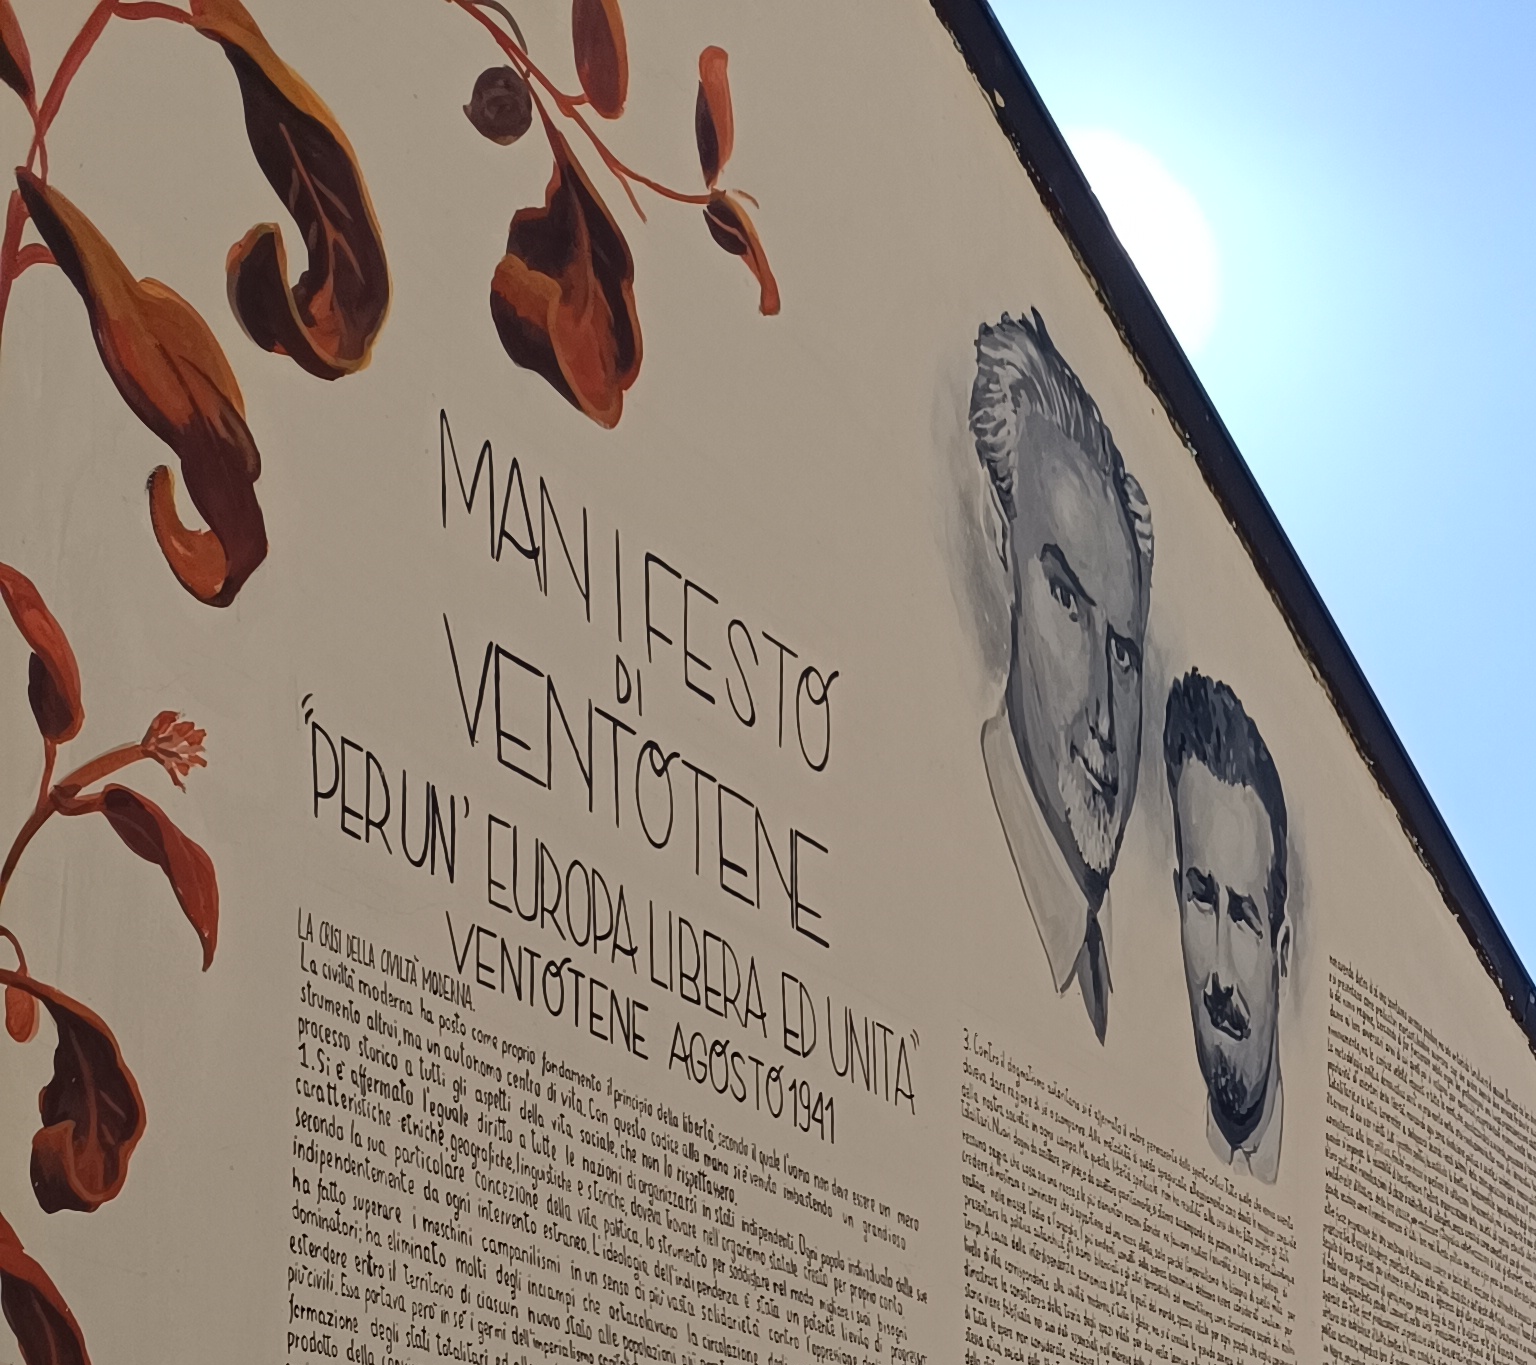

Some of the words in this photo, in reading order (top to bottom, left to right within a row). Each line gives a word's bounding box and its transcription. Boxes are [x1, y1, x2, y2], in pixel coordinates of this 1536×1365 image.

[438, 408, 840, 773] MANIFESTO
[615, 655, 643, 717] DI
[442, 612, 830, 948] VENTOTENE
[298, 907, 314, 944] LA
[319, 921, 342, 955] CRISI
[347, 933, 376, 970] DELLA
[486, 813, 638, 975] EUROPA
[648, 898, 768, 1039] LIBERA
[781, 970, 818, 1059] ED
[298, 1017, 351, 1052] processo
[358, 1035, 399, 1071] storico
[405, 1059, 414, 1078] a
[419, 1056, 446, 1094] tutti
[453, 1076, 467, 1104] gli
[475, 1087, 511, 1125] aspetti
[520, 1100, 545, 1136] della
[300, 980, 361, 1025] strumento
[403, 1028, 423, 1052] ma
[427, 1038, 441, 1058] un
[444, 1042, 503, 1083] autonomo
[507, 1069, 541, 1098] centro
[547, 1082, 557, 1104] di
[301, 941, 319, 977] La
[358, 979, 414, 1016] moderna
[420, 997, 435, 1025] ha
[471, 1027, 499, 1051] come
[502, 1040, 536, 1066] proprio
[614, 1089, 653, 1118] principio
[445, 910, 649, 1061] VENTOTENE
[667, 1021, 789, 1120] AGOSTO
[788, 1079, 837, 1145] 1941
[317, 1048, 331, 1077] Si
[351, 1064, 414, 1106] affermato
[477, 1112, 513, 1144] diritto
[295, 1106, 345, 1142] secondo
[350, 1119, 364, 1149] la
[367, 1136, 388, 1157] sua
[395, 1145, 465, 1184] particolare
[475, 1170, 539, 1211] concezione
